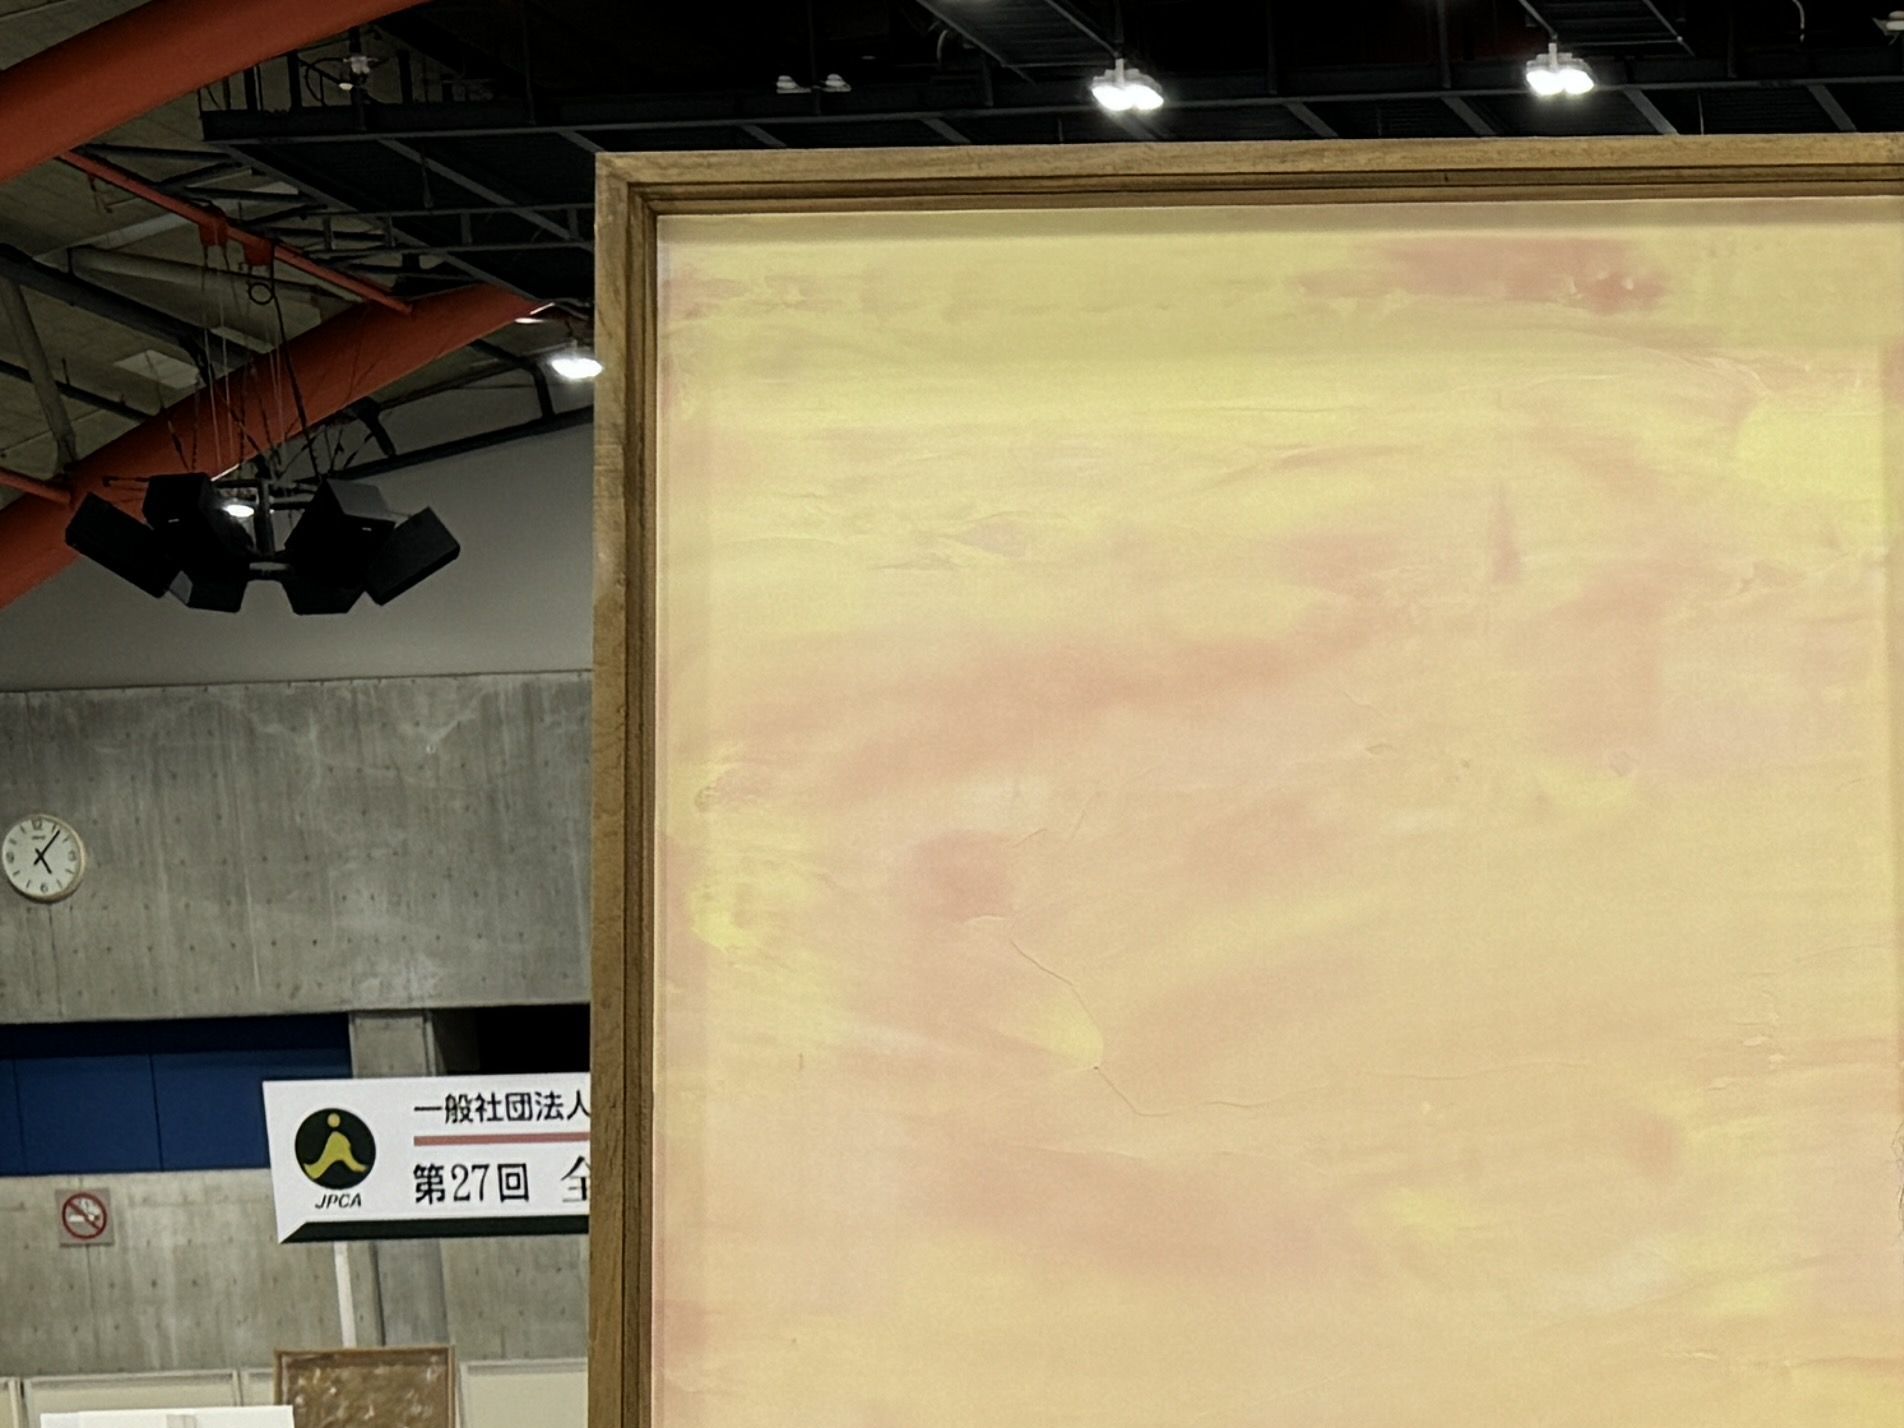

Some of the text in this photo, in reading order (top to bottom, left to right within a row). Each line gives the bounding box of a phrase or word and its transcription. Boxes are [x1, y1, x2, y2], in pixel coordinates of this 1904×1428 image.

[414, 1090, 590, 1123] 一般社団法人
[413, 1162, 529, 1204] 第27回
[315, 1192, 362, 1209] JPCA
